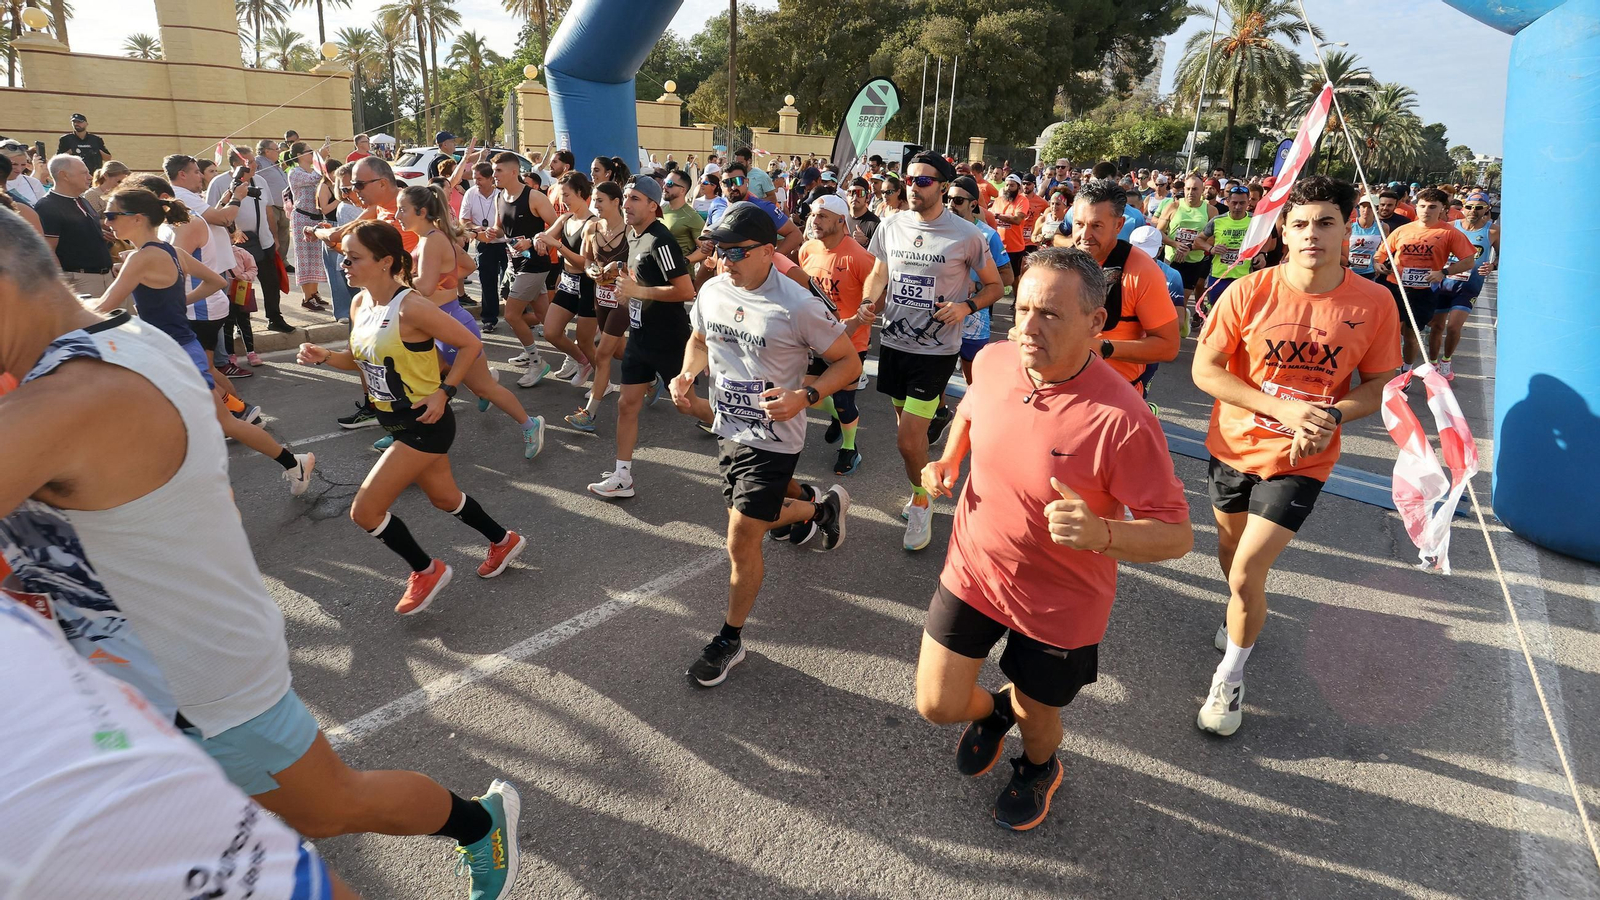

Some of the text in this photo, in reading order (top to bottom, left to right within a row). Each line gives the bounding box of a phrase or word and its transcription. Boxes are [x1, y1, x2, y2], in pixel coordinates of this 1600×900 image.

[890, 250, 946, 264] PINTAMONA
[599, 290, 612, 300] 266
[901, 285, 922, 298] 652
[706, 320, 766, 348] PINTAMONA
[724, 390, 752, 406] 990
[490, 828, 506, 870] HOKA
